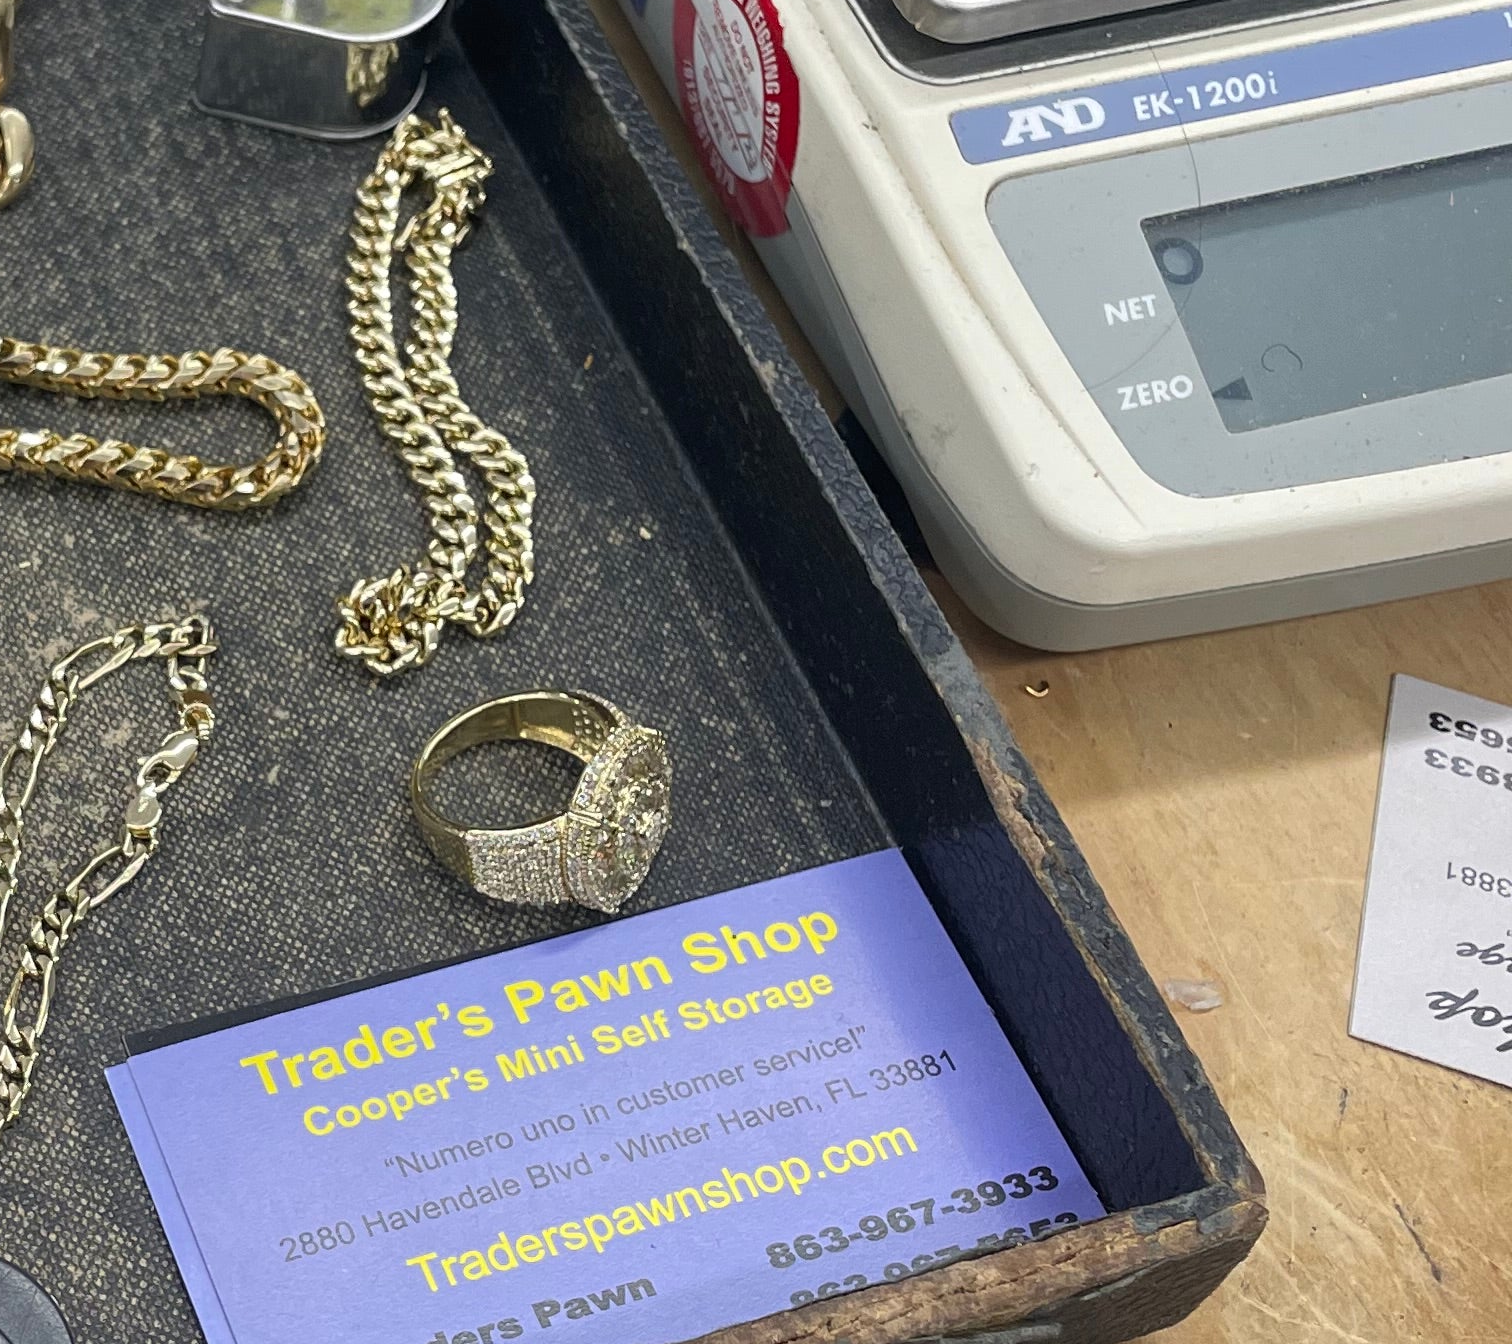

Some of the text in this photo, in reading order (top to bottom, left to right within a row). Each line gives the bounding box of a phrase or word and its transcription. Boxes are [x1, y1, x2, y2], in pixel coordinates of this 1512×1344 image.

[1132, 70, 1279, 121] EK-1200i
[1103, 294, 1157, 326] NET
[1116, 374, 1194, 411] ZERO
[1428, 711, 1512, 754] 653
[1456, 942, 1512, 973] ge
[239, 911, 838, 1095] Trader's Pawn Shop
[303, 973, 834, 1136] Cooper's Mini Self Storage
[520, 1112, 576, 1143] uno
[580, 1102, 611, 1126] in
[616, 1064, 745, 1116] customer
[279, 1049, 958, 1263] 2880 Havendale Blvd Winter Haven, FL 33881
[405, 1125, 918, 1293] Traderspawnshop.com
[765, 1165, 1059, 1269] 863-967-3933
[530, 1276, 658, 1329] Pawn
